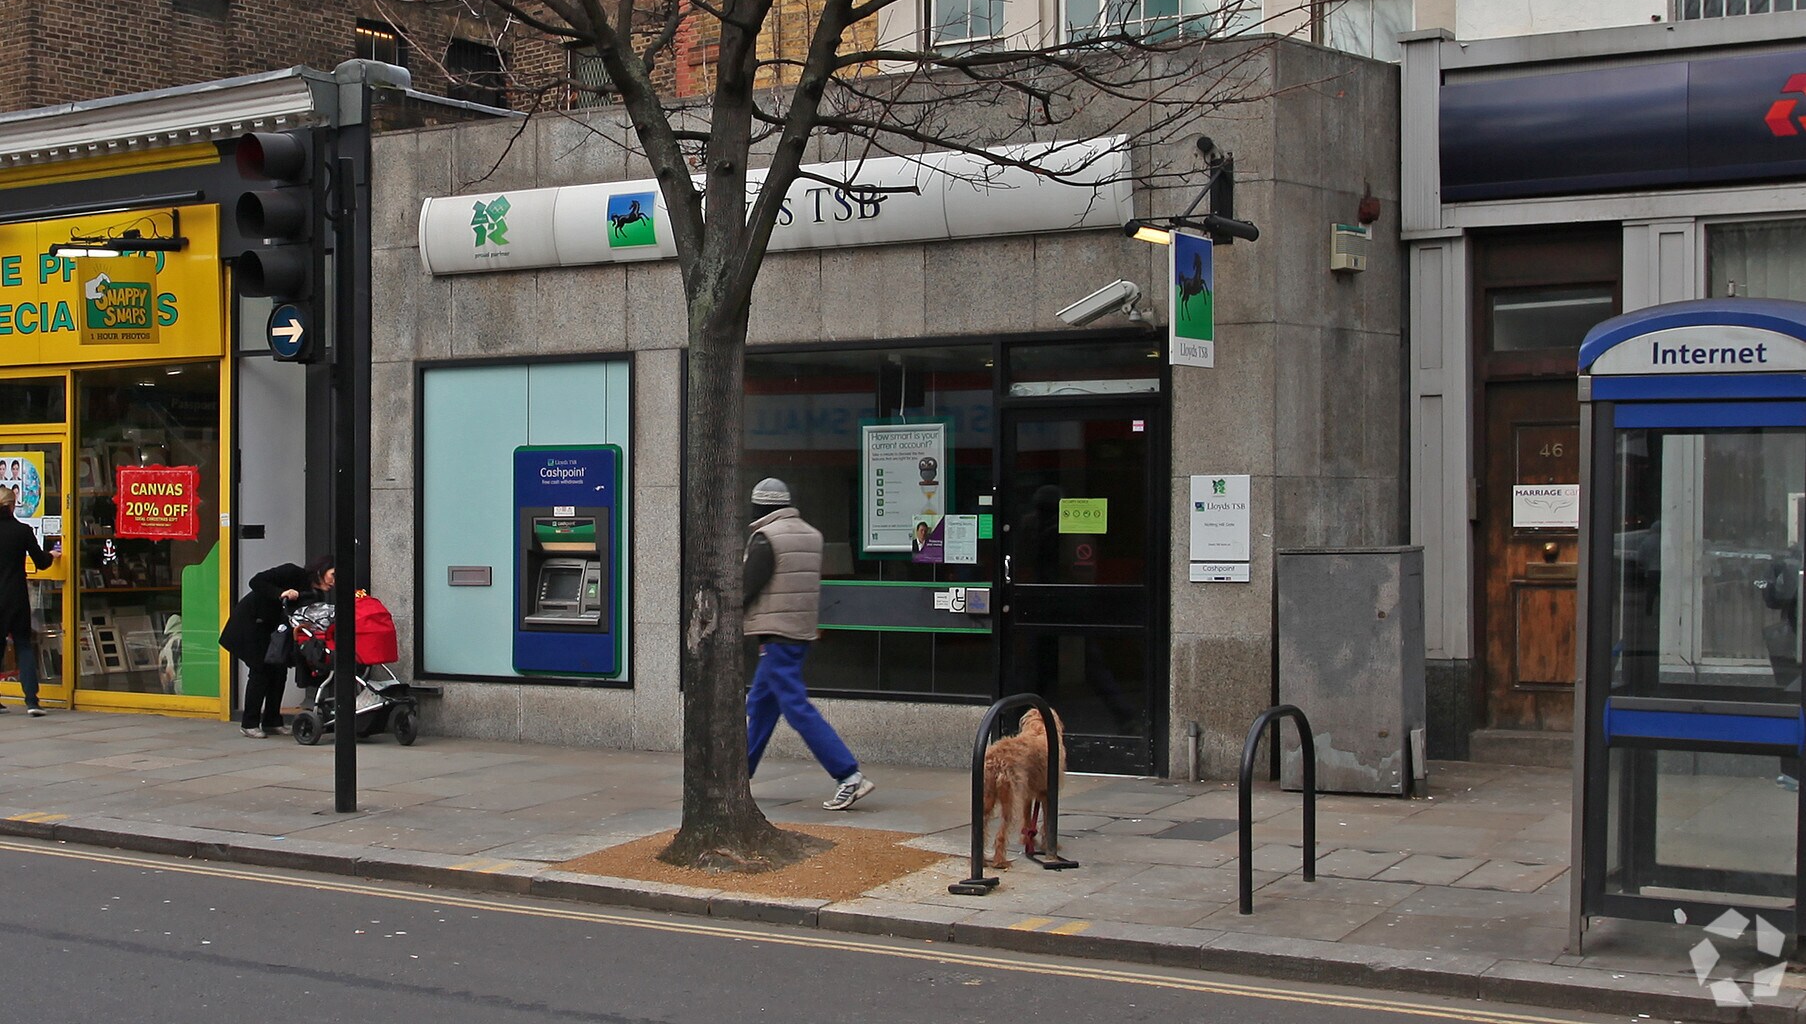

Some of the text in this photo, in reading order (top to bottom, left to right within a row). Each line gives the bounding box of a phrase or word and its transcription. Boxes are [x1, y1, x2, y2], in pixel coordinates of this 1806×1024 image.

[804, 183, 882, 223] TSB
[95, 285, 148, 311] SNAPPY
[103, 306, 146, 327] SNAPS
[121, 332, 151, 340] PHOTOS
[1180, 342, 1209, 360] Lloyds TSB
[1652, 341, 1767, 364] Internet
[871, 432, 889, 441] How
[921, 432, 939, 441] your
[872, 440, 933, 450] current account?
[1540, 443, 1563, 457] 46
[540, 467, 586, 479] Cashpoint
[130, 483, 183, 496] CANVAS
[125, 501, 189, 516] 20% OFF
[1207, 502, 1230, 512] Lloyds
[1203, 565, 1236, 573] Cashpoint
